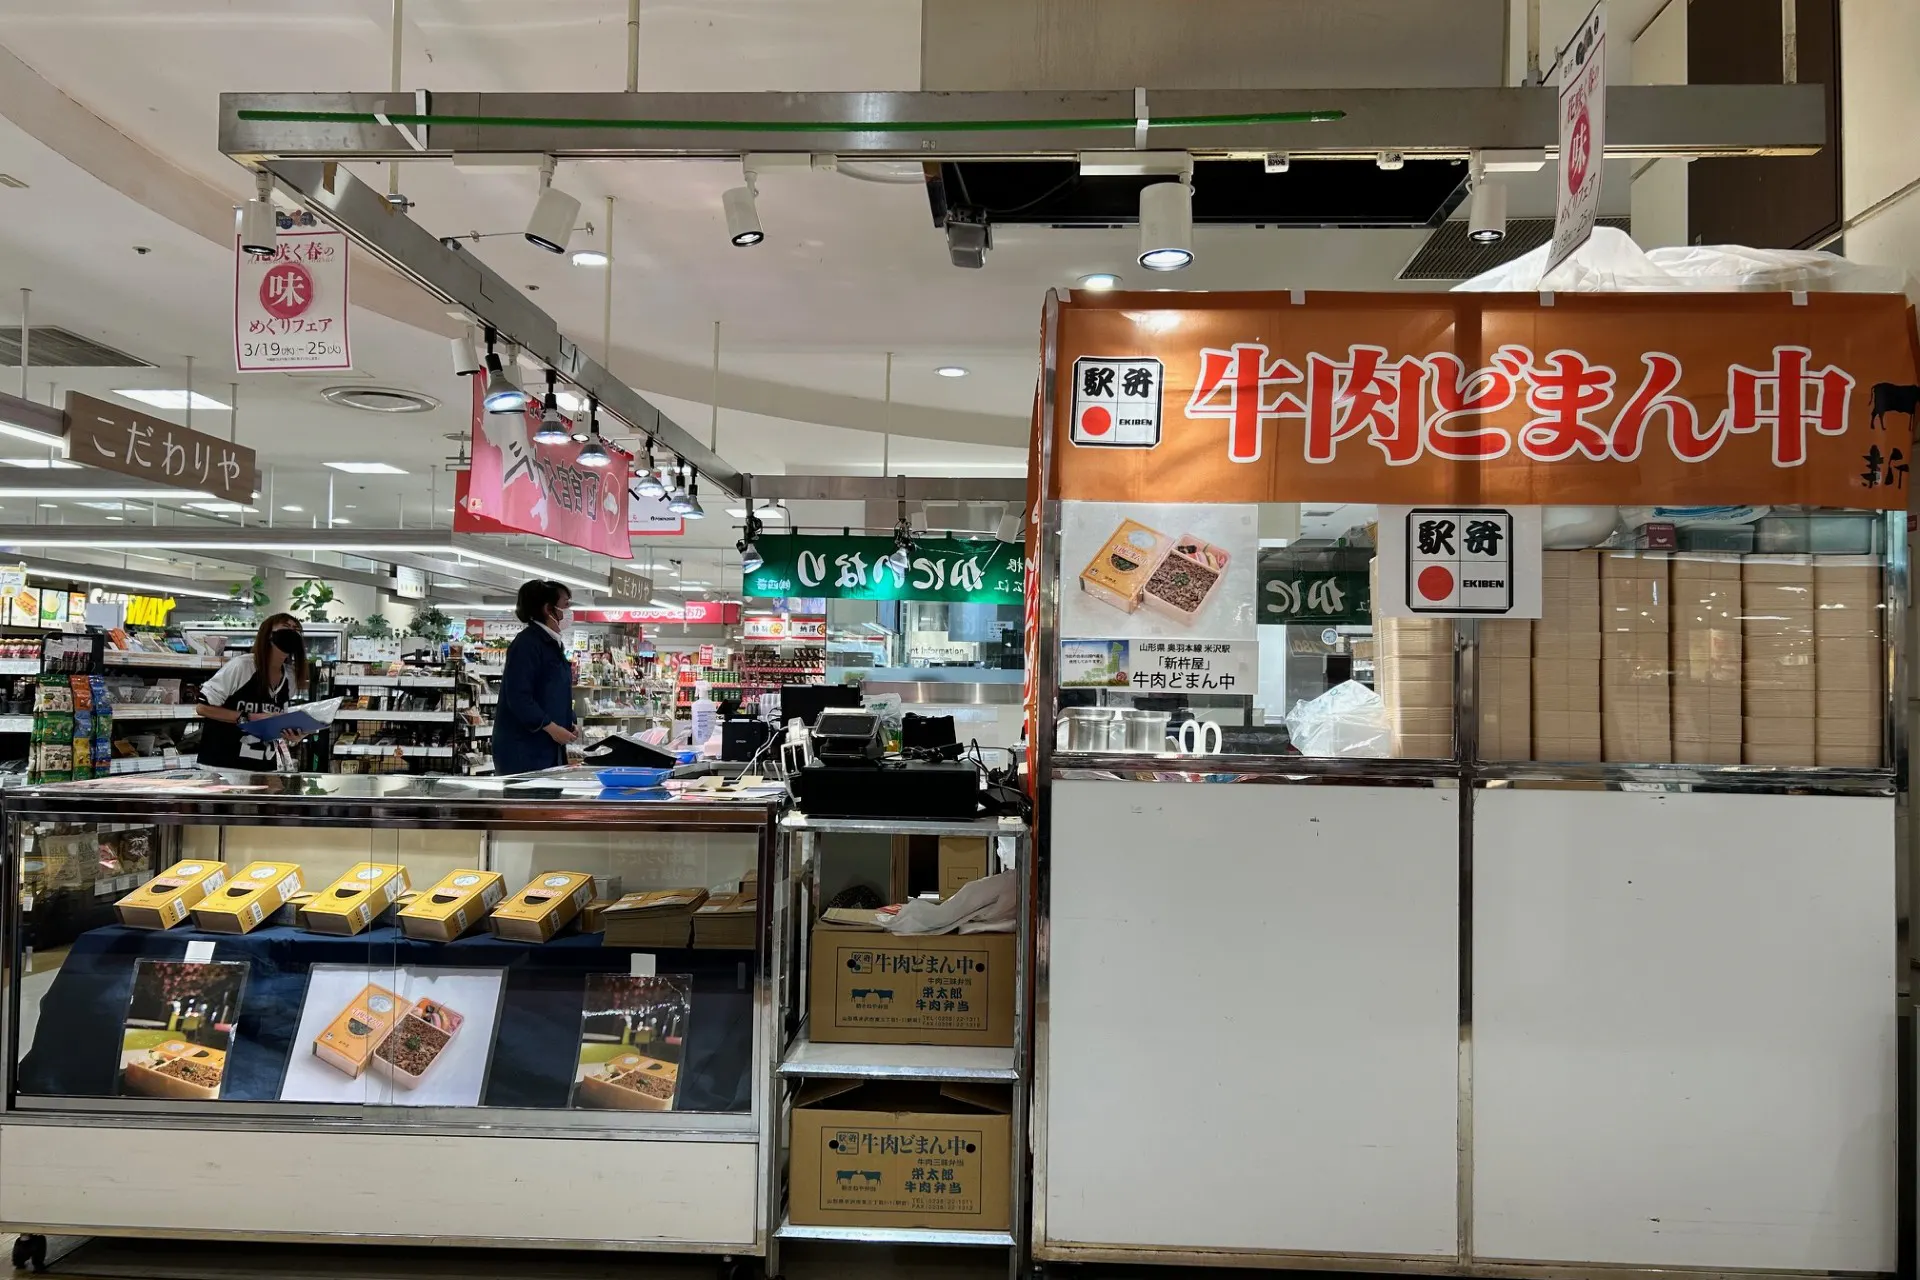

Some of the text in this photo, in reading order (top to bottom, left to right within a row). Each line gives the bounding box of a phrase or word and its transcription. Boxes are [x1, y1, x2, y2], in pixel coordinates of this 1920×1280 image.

[1571, 123, 1588, 180] 味
[269, 271, 305, 307] 味
[249, 318, 333, 335] めぐりフェア
[1082, 366, 1154, 399] 駅弁
[1184, 342, 1856, 468] 牛肉どまん中
[1118, 418, 1153, 427] EKIBEN
[92, 416, 241, 491] こだわりや
[1860, 444, 1909, 489] 新
[1417, 520, 1504, 556] 駅弁
[615, 576, 650, 600] こだわりや
[1463, 579, 1505, 588] EKIBEN
[1139, 643, 1231, 653] 山形県 奥羽本線 米沢駅
[1158, 656, 1211, 670] 「新杵屋」
[1132, 671, 1236, 690] 牛肉どまん中
[875, 953, 975, 975] 牛肉どまん中
[922, 986, 963, 1000] 栄太郎
[915, 999, 970, 1012] 牛肉弁当
[861, 1133, 967, 1156] 牛肉どまん中
[911, 1167, 954, 1181] 栄太郎
[904, 1181, 962, 1194] 牛肉弁当
